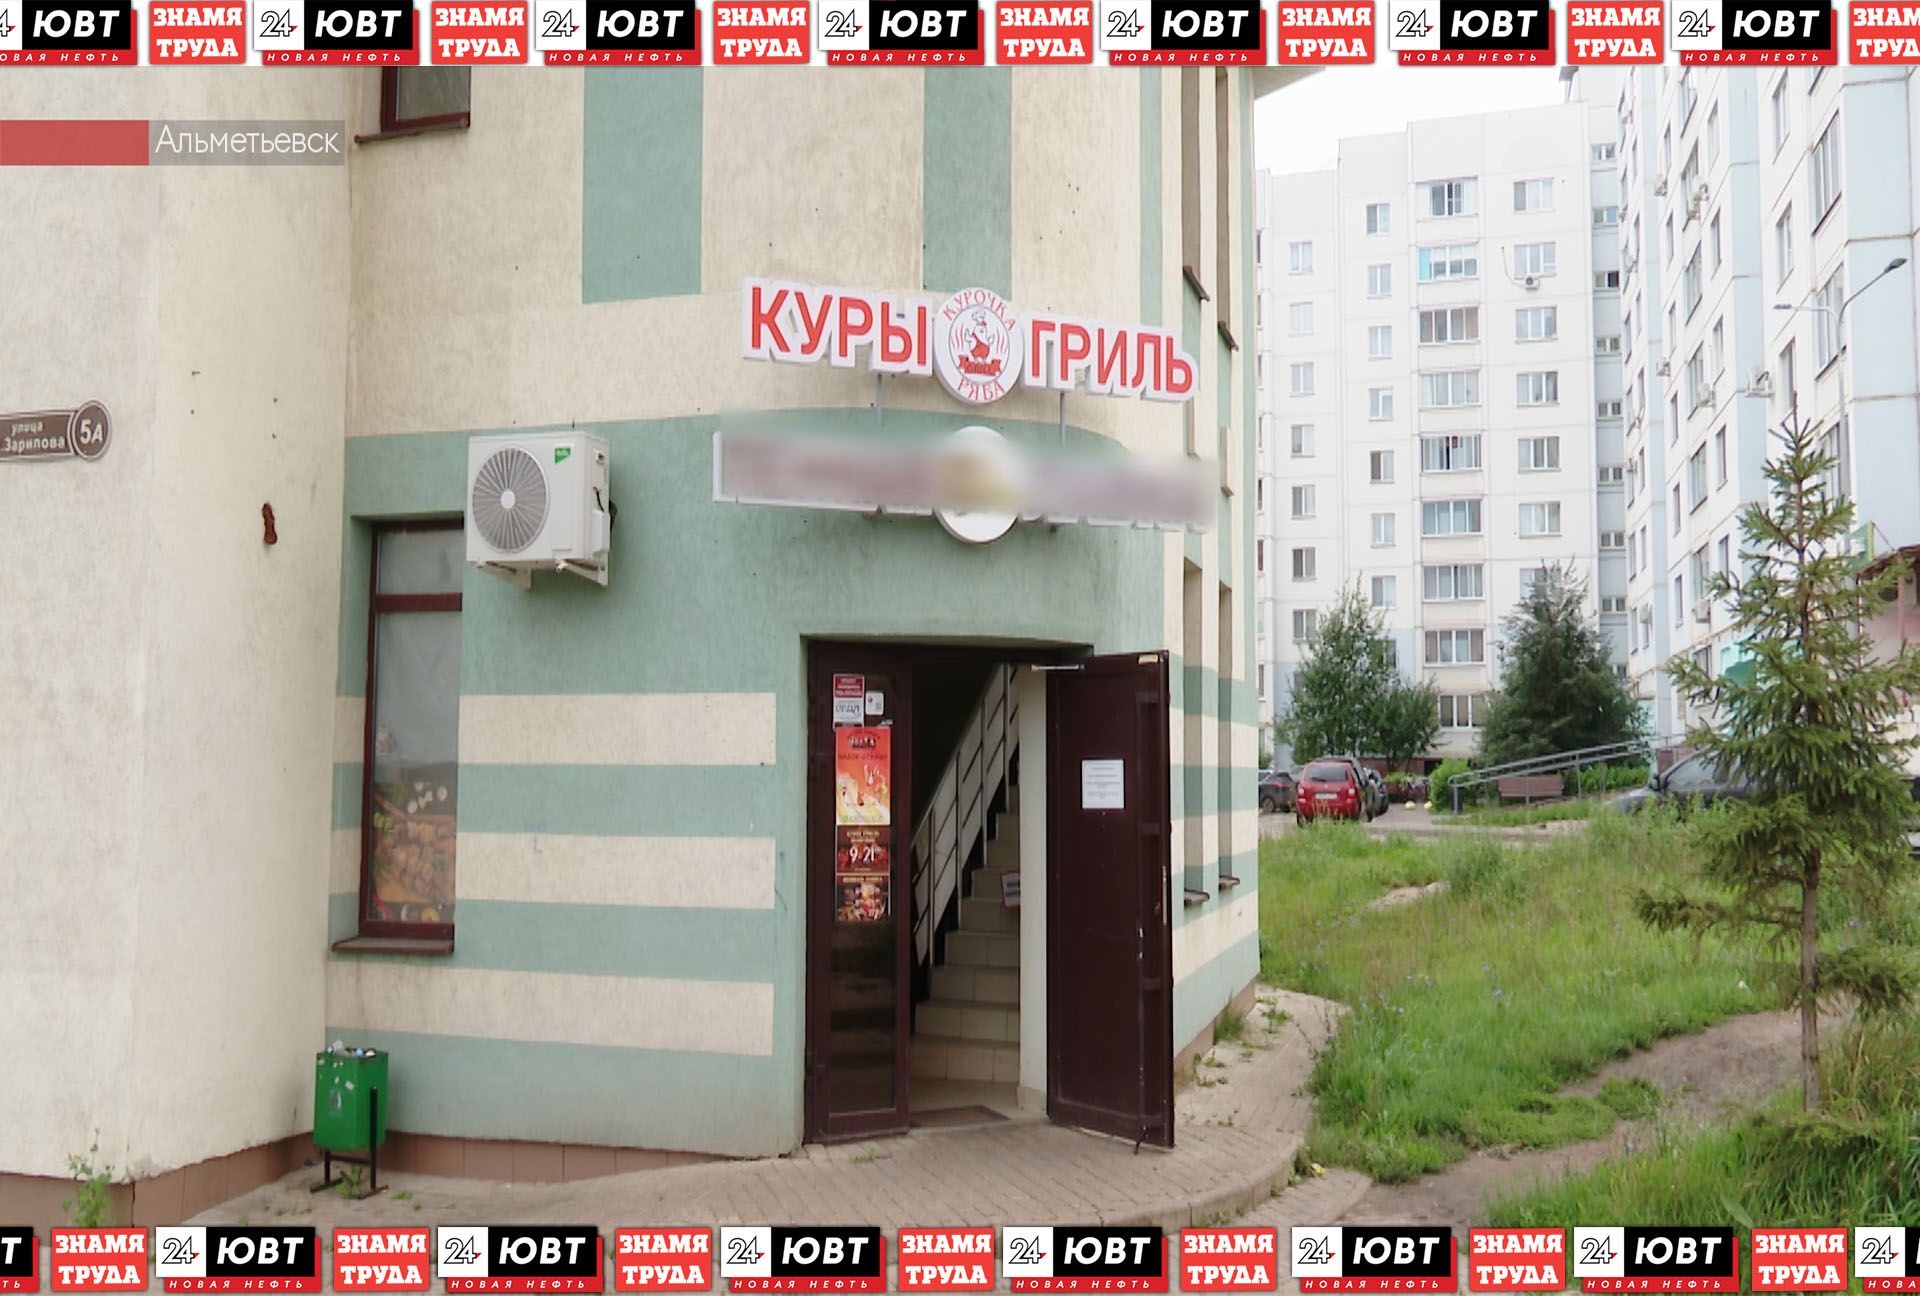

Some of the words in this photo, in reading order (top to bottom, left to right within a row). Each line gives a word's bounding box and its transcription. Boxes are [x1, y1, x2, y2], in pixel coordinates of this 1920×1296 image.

[943, 289, 1016, 331] КУРОЧКА
[752, 287, 926, 365] КУРЫ
[1032, 320, 1192, 393] ГРИЛЬ
[11, 421, 43, 436] улица
[79, 419, 103, 444] 5А
